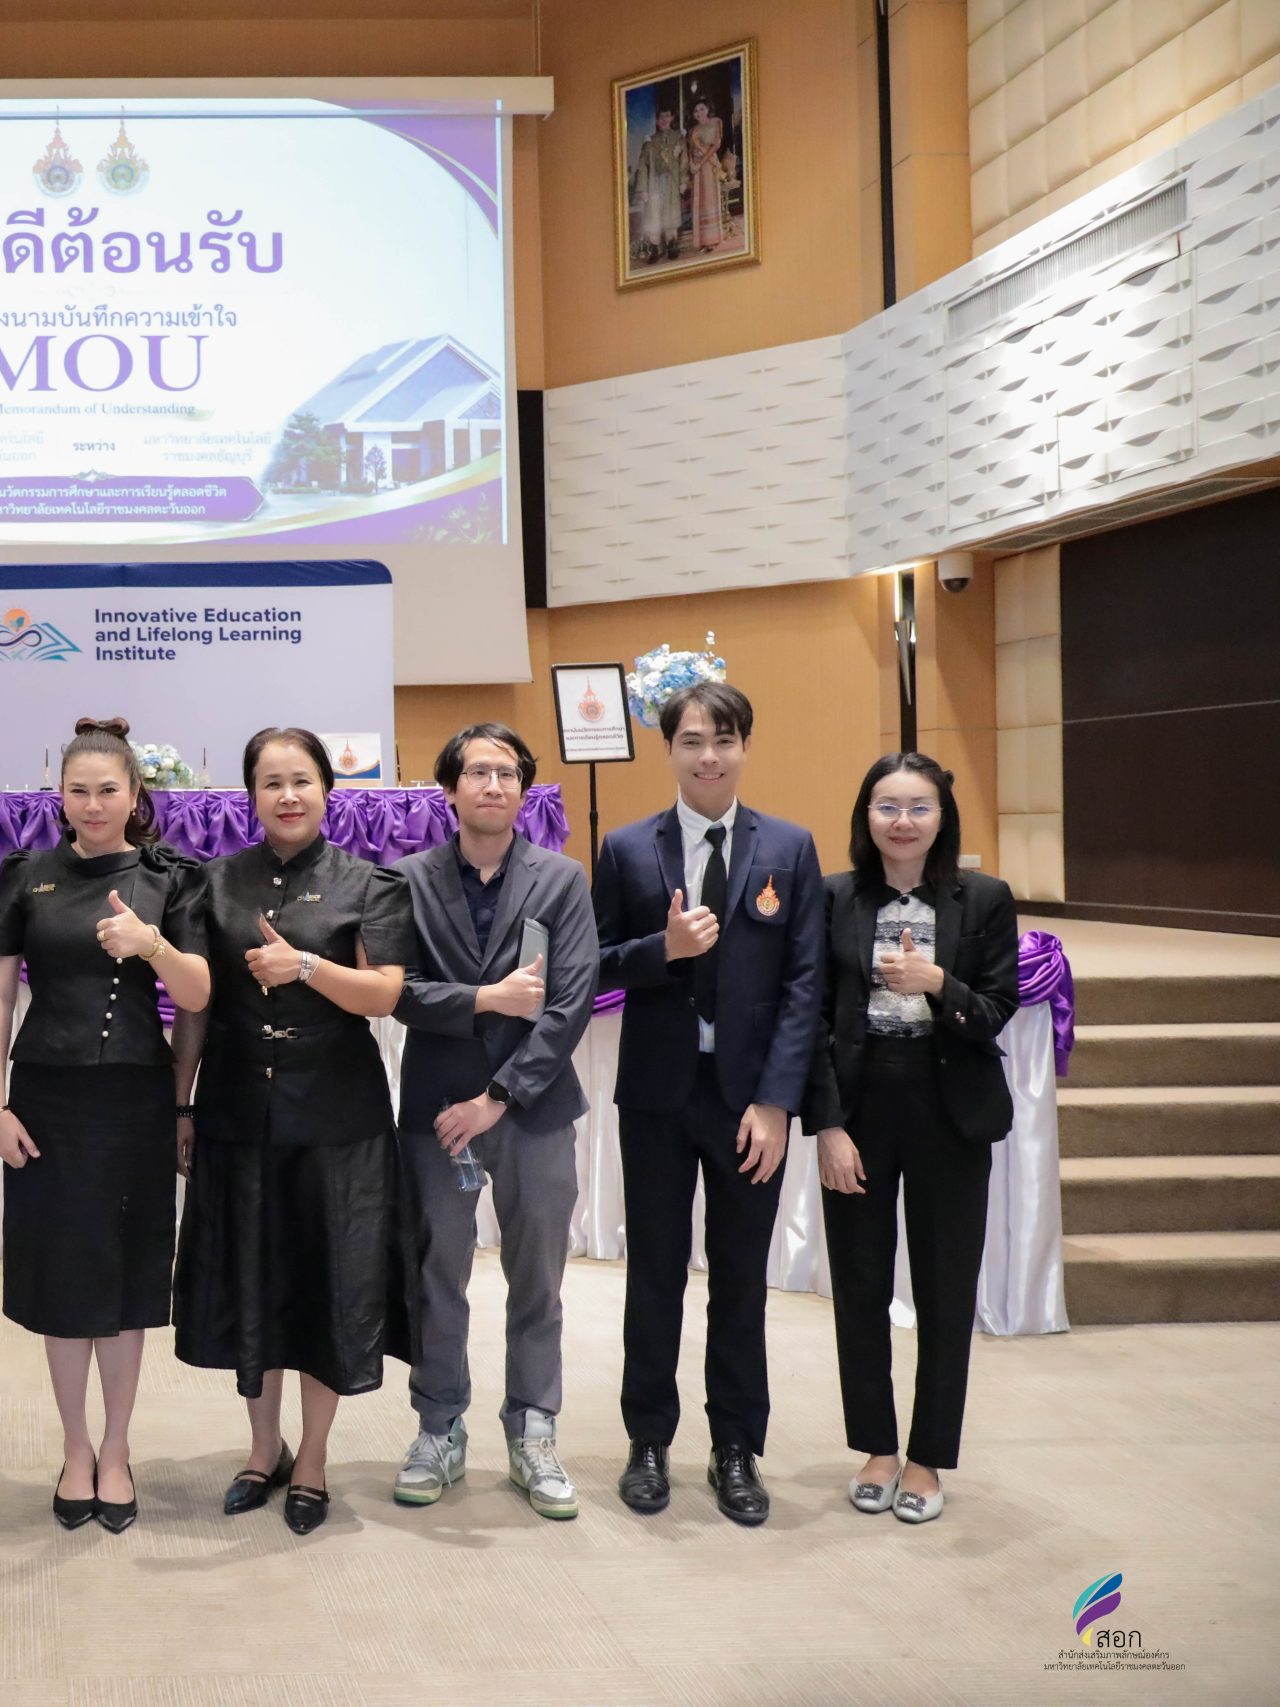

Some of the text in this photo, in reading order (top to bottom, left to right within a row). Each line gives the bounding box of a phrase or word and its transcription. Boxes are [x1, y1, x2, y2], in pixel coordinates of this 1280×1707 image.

[84, 403, 97, 415] of
[101, 403, 197, 417] Understanding
[72, 438, 116, 451] ระหว่าง
[94, 607, 302, 624] Innovative Education
[94, 626, 302, 645] and Lifelong Learning
[95, 646, 177, 661] Institute
